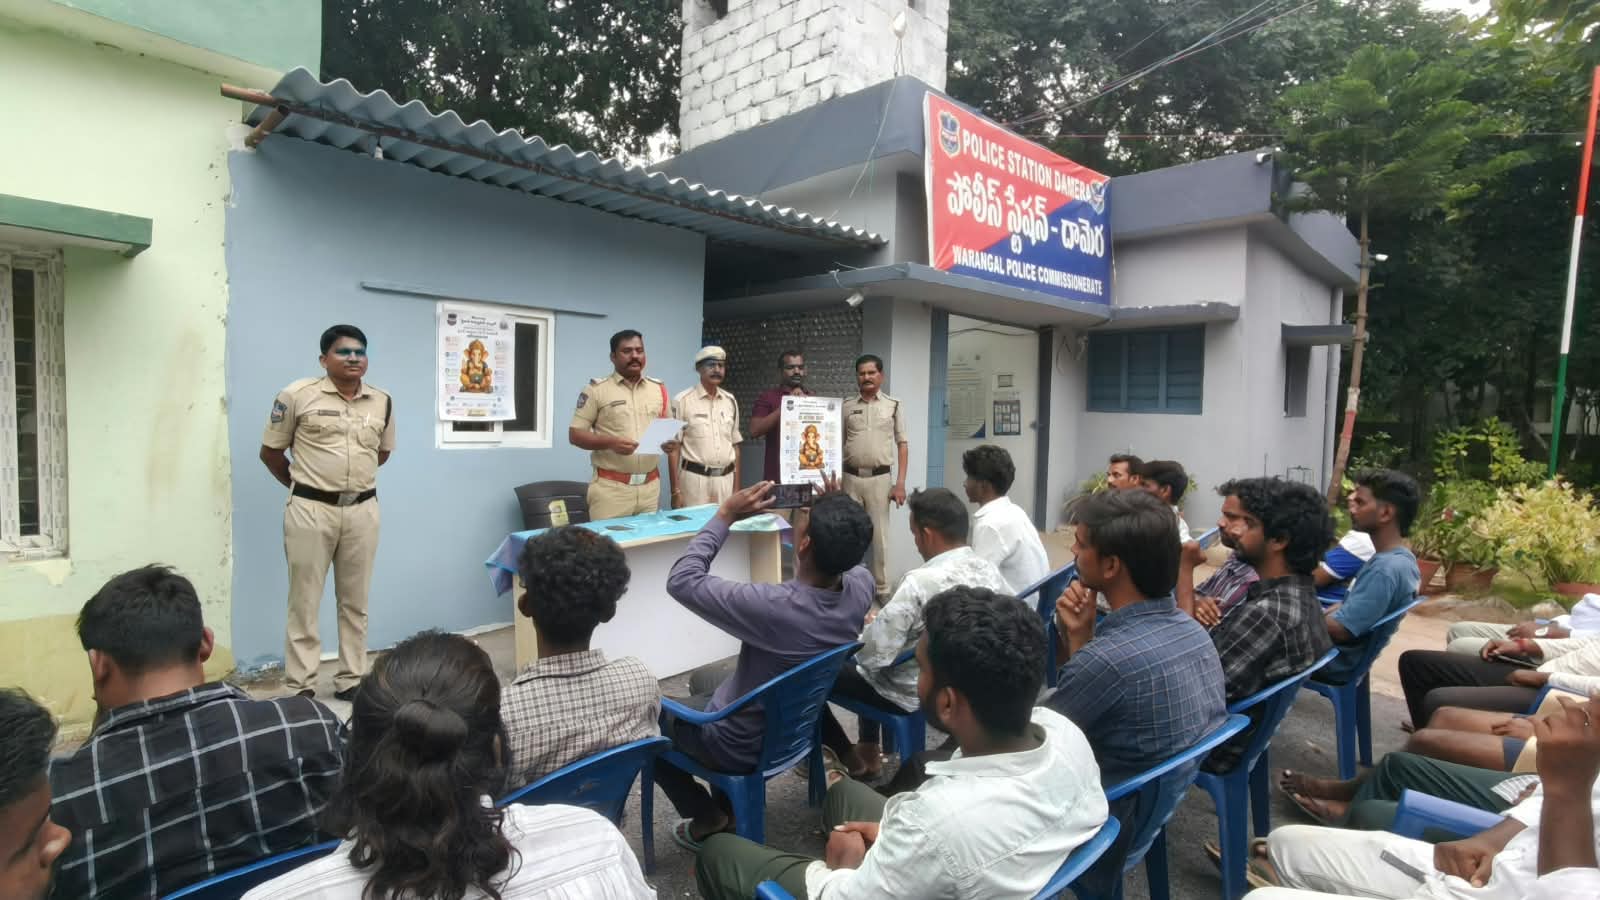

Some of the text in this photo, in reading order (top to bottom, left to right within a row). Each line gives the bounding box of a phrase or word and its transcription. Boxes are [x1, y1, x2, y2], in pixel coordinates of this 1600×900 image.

[962, 129, 1092, 202] POLICE STATION DAMERA
[946, 171, 1002, 228] పోలీస్
[1004, 185, 1049, 254] స్టేషన్
[1061, 217, 1105, 258] దామెర
[952, 245, 1103, 296] WARANGAL POLICE COMMISSIONERATE
